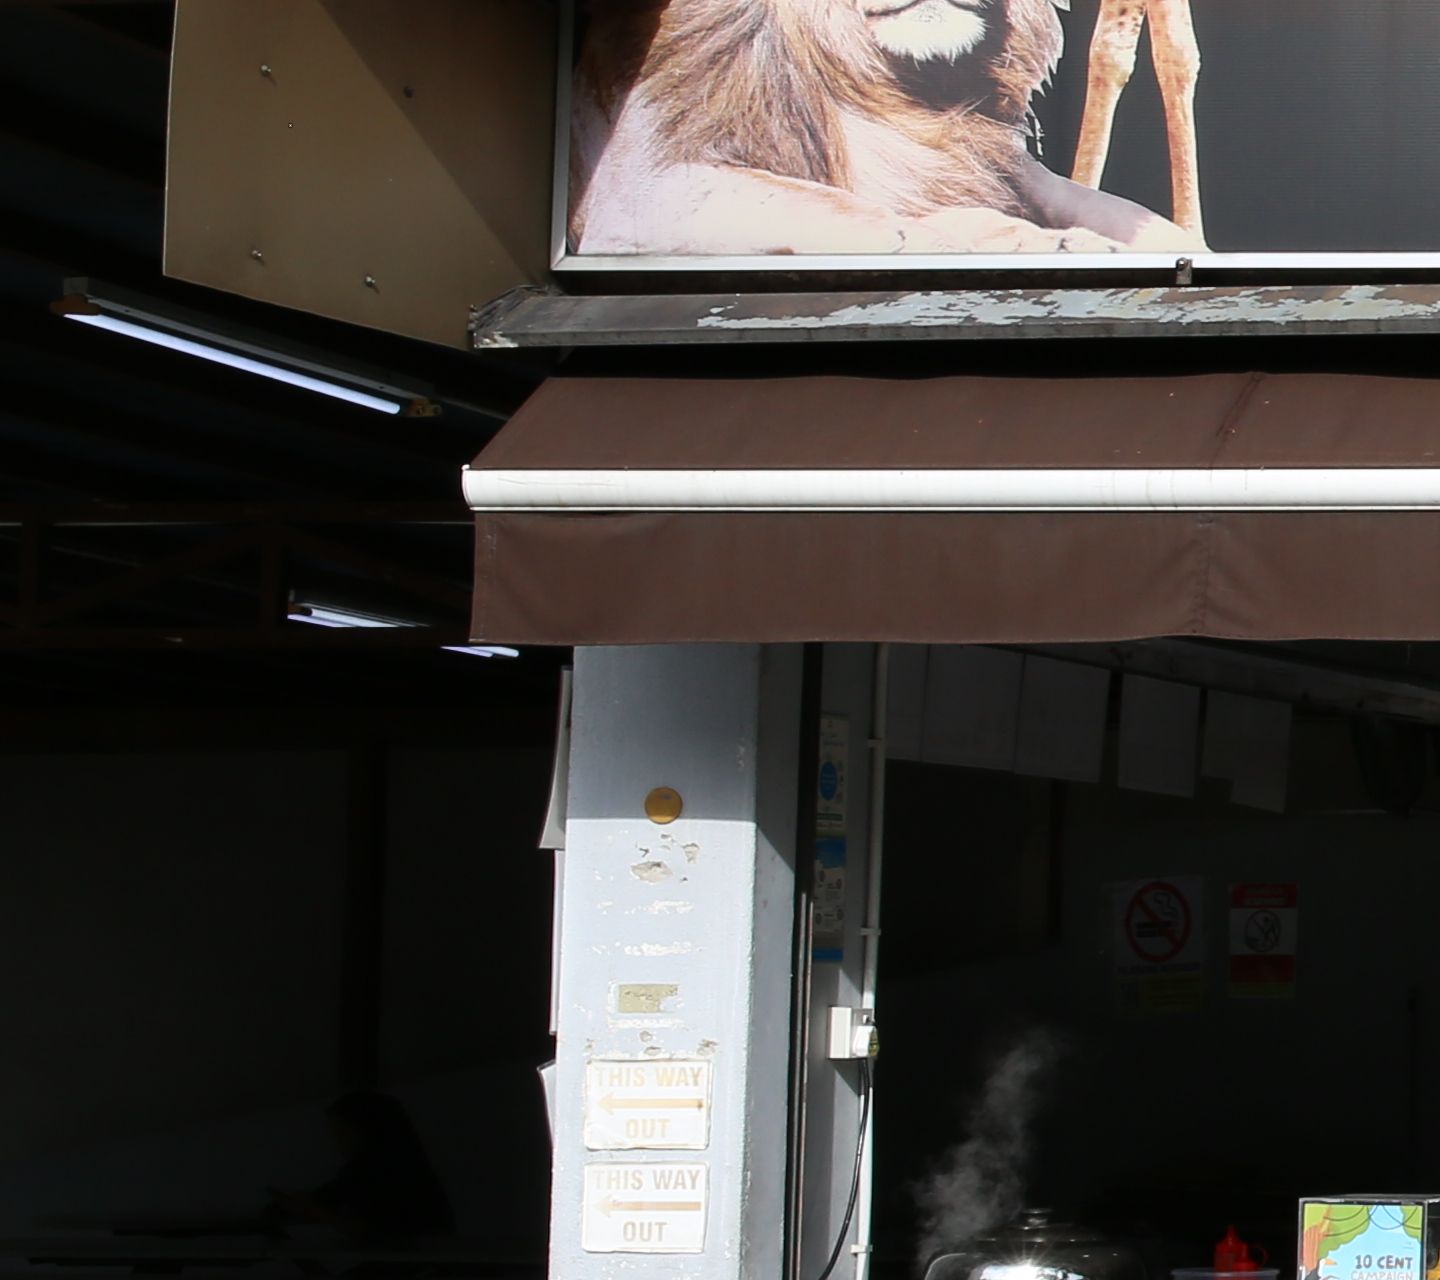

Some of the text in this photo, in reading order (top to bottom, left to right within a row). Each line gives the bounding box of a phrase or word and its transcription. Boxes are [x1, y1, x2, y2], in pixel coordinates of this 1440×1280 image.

[595, 1065, 704, 1087] THIS WAY
[624, 1118, 671, 1139] OUT
[593, 1169, 702, 1191] THIS WAY
[622, 1220, 668, 1242] OUT
[1355, 1254, 1414, 1270] 10 CENT
